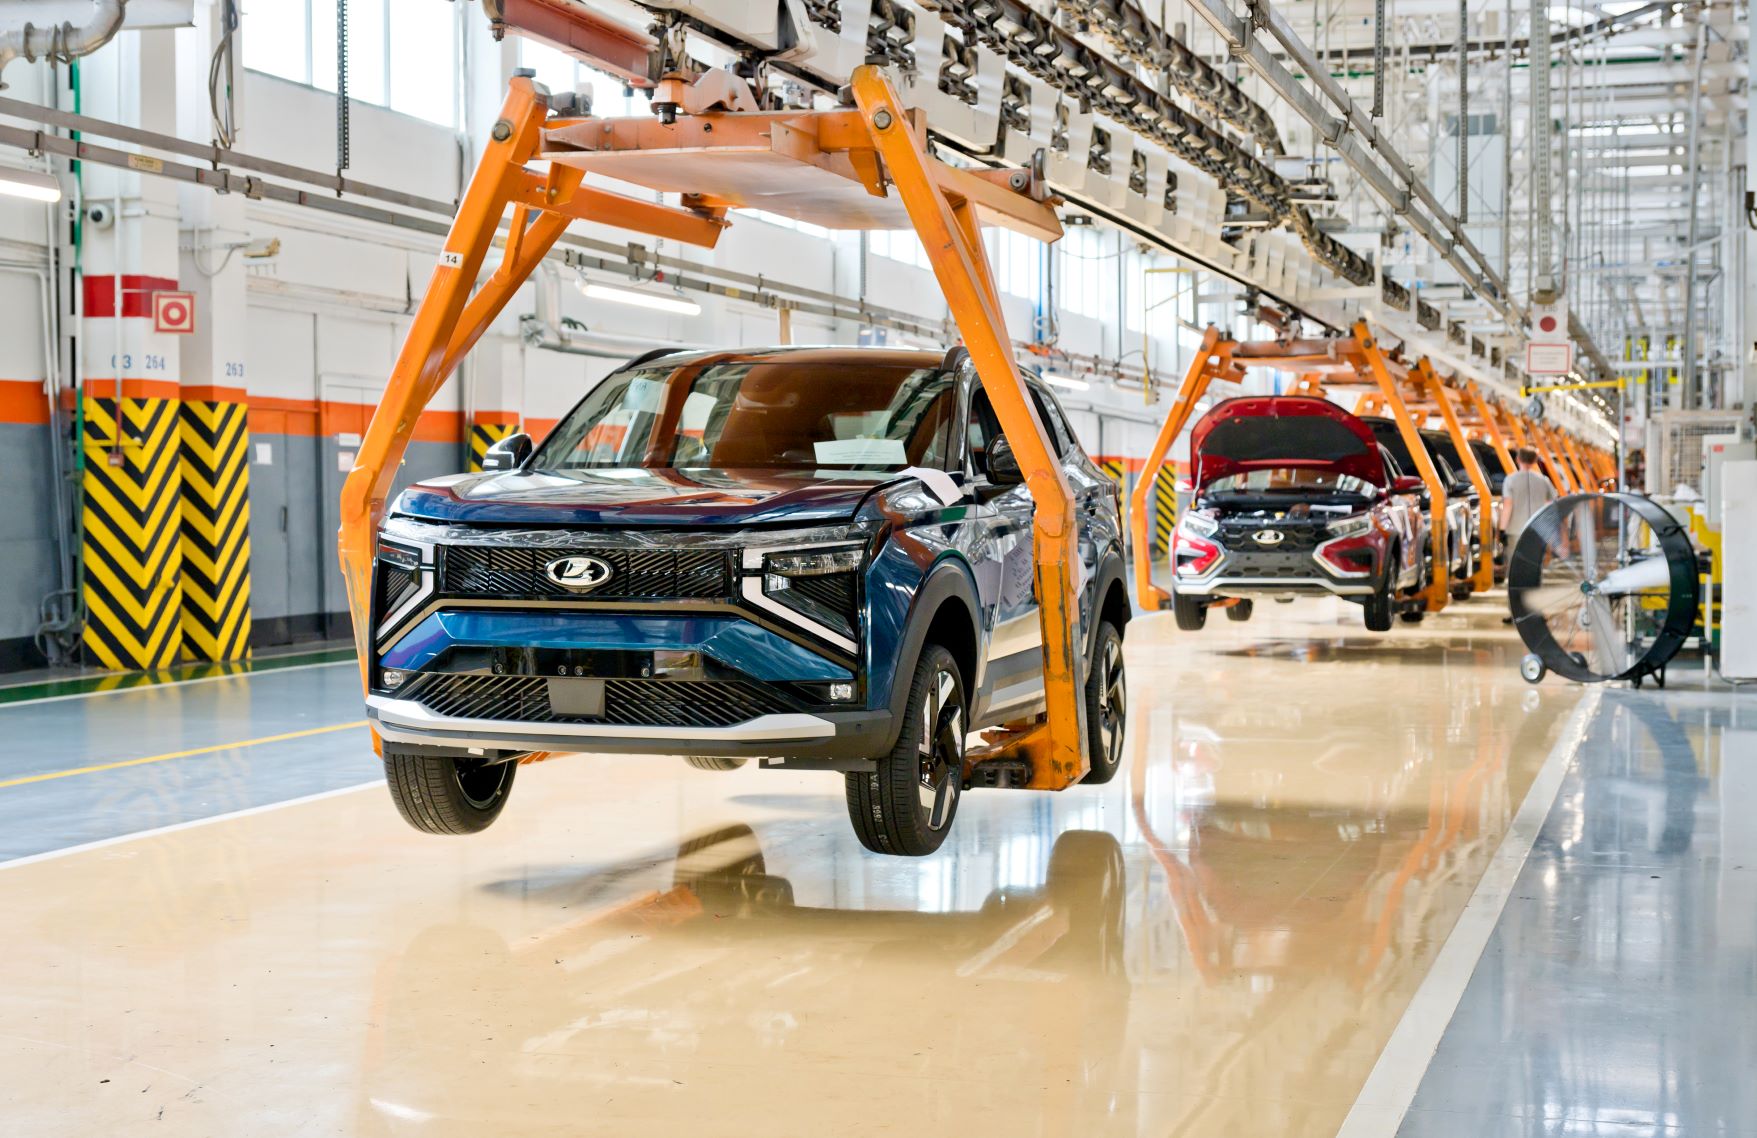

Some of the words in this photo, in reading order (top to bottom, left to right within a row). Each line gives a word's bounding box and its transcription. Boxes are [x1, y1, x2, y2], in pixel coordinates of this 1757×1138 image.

[445, 254, 457, 264] 14
[145, 354, 165, 370] 264
[225, 362, 244, 377] 263
